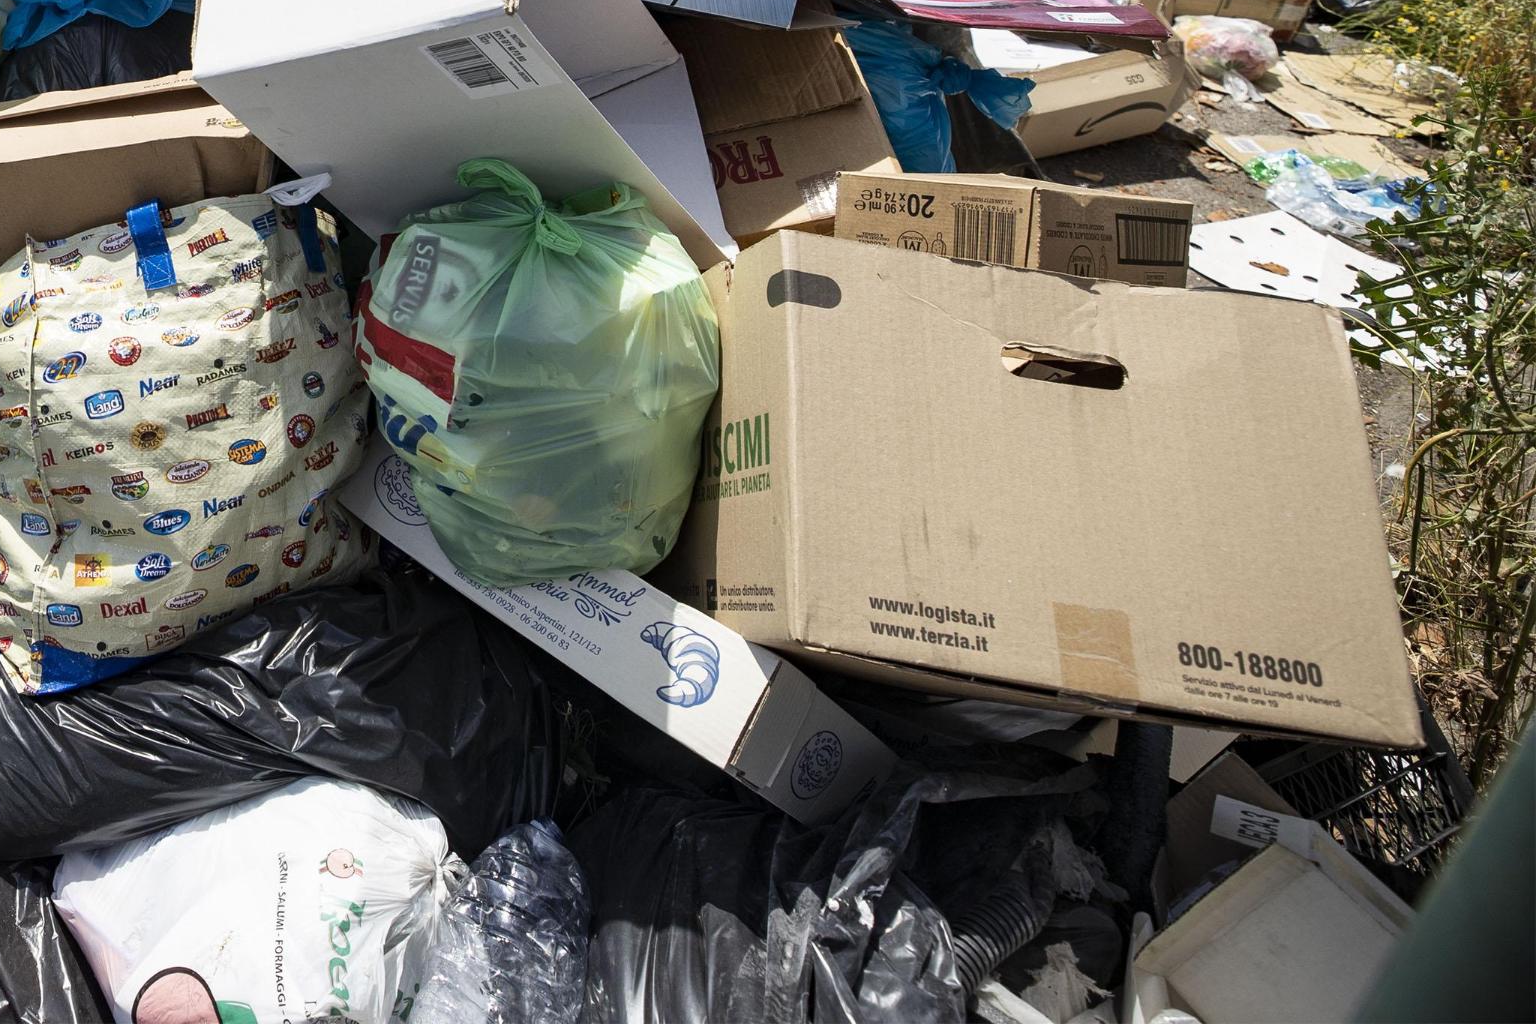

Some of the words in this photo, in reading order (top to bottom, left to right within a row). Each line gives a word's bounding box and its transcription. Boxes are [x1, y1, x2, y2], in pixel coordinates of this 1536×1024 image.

[885, 191, 896, 201] 74
[907, 193, 935, 218] 20
[884, 203, 896, 213] 90
[231, 258, 262, 276] White
[392, 242, 435, 323] SERVUS
[139, 374, 180, 398] Near
[197, 364, 247, 386] RADAMES
[89, 396, 120, 413] Land
[65, 442, 114, 461] KEIROS
[228, 440, 265, 459] SISTEMA
[701, 412, 771, 477] ISCIMI
[171, 466, 206, 482] DOLCIANDO
[258, 472, 296, 498] ONDINA
[733, 480, 740, 496] IL
[742, 473, 771, 494] PIANETA
[203, 494, 246, 520] Near
[25, 519, 48, 532] Land
[91, 525, 136, 536] RADAMES
[153, 515, 182, 530] Blues
[139, 554, 165, 568] Soft
[569, 572, 646, 608] Anmol
[720, 585, 727, 596] Un
[728, 586, 741, 596] unico
[742, 584, 775, 597] distributore,
[101, 597, 150, 619] Dexal
[169, 594, 203, 610] DOLCIANDO
[720, 603, 727, 611] un
[728, 601, 758, 611] distributore
[758, 601, 775, 611] unico.
[869, 596, 996, 629] www.logista.it
[49, 610, 79, 623] Land
[482, 587, 496, 600] 730
[496, 597, 515, 613] 0928
[519, 613, 531, 625] 06
[531, 620, 546, 634] 200
[547, 631, 558, 642] 60
[558, 639, 570, 651] 83
[505, 588, 530, 609] Amico
[530, 606, 566, 634] Aspertini,
[569, 630, 602, 656] 121/123
[870, 621, 989, 652] www.terzia.it
[1178, 641, 1323, 688] 800-188800
[1182, 674, 1217, 688] Servizio
[1220, 682, 1245, 693] attivo
[1247, 685, 1261, 695] dal
[1296, 692, 1304, 700] al
[1184, 686, 1204, 696] dalle
[1208, 691, 1222, 700] ore
[1233, 694, 1248, 703] alle
[1251, 698, 1266, 706] ore
[1268, 699, 1279, 708] 19
[276, 892, 286, 931] SALUMI
[274, 939, 286, 1007] FORMAGGI
